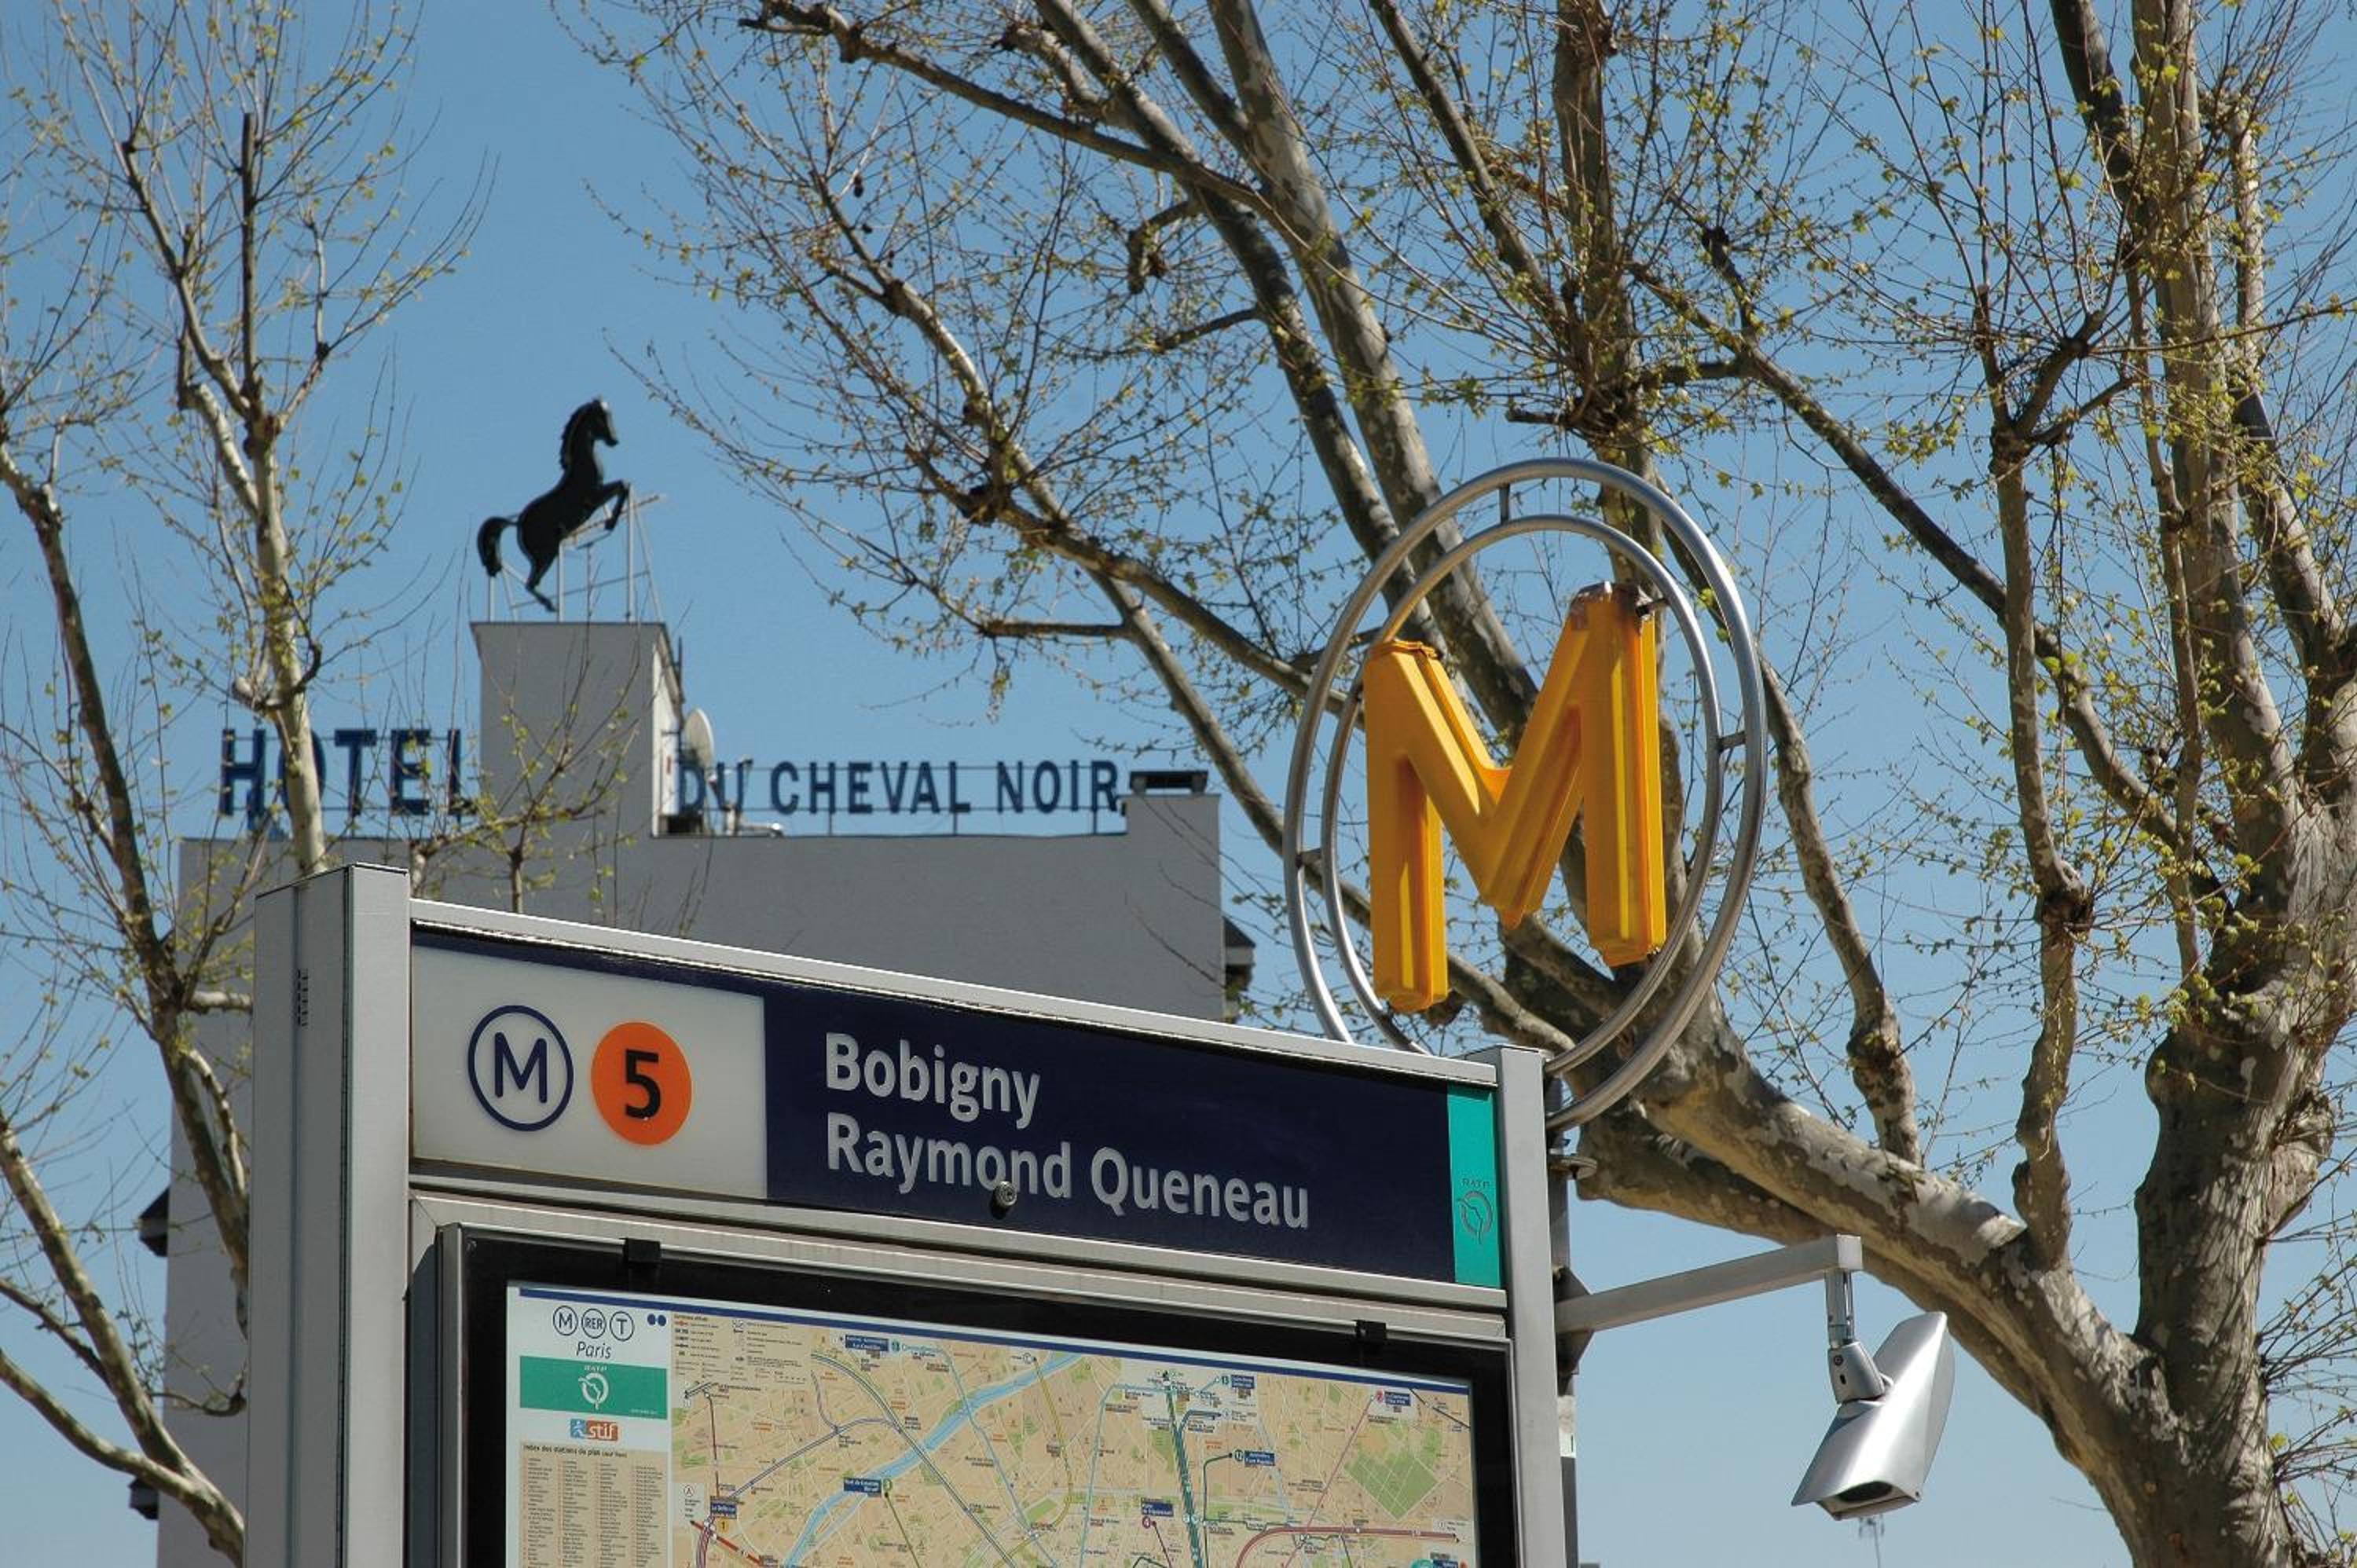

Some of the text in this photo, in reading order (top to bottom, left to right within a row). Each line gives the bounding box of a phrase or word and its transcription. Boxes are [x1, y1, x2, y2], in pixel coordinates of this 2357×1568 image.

[677, 760, 745, 814] DU
[770, 760, 970, 815] CHEVAL
[996, 760, 1120, 814] NOIR
[1363, 581, 1666, 1014] M
[494, 1031, 661, 1119] M 5
[826, 1031, 1041, 1129] Bobigny
[827, 1112, 1308, 1230] Raymond Queneau
[1461, 1178, 1490, 1189] RATP
[559, 1313, 627, 1335] M RER T
[576, 1341, 612, 1359] Paris
[589, 1423, 617, 1439] stif
